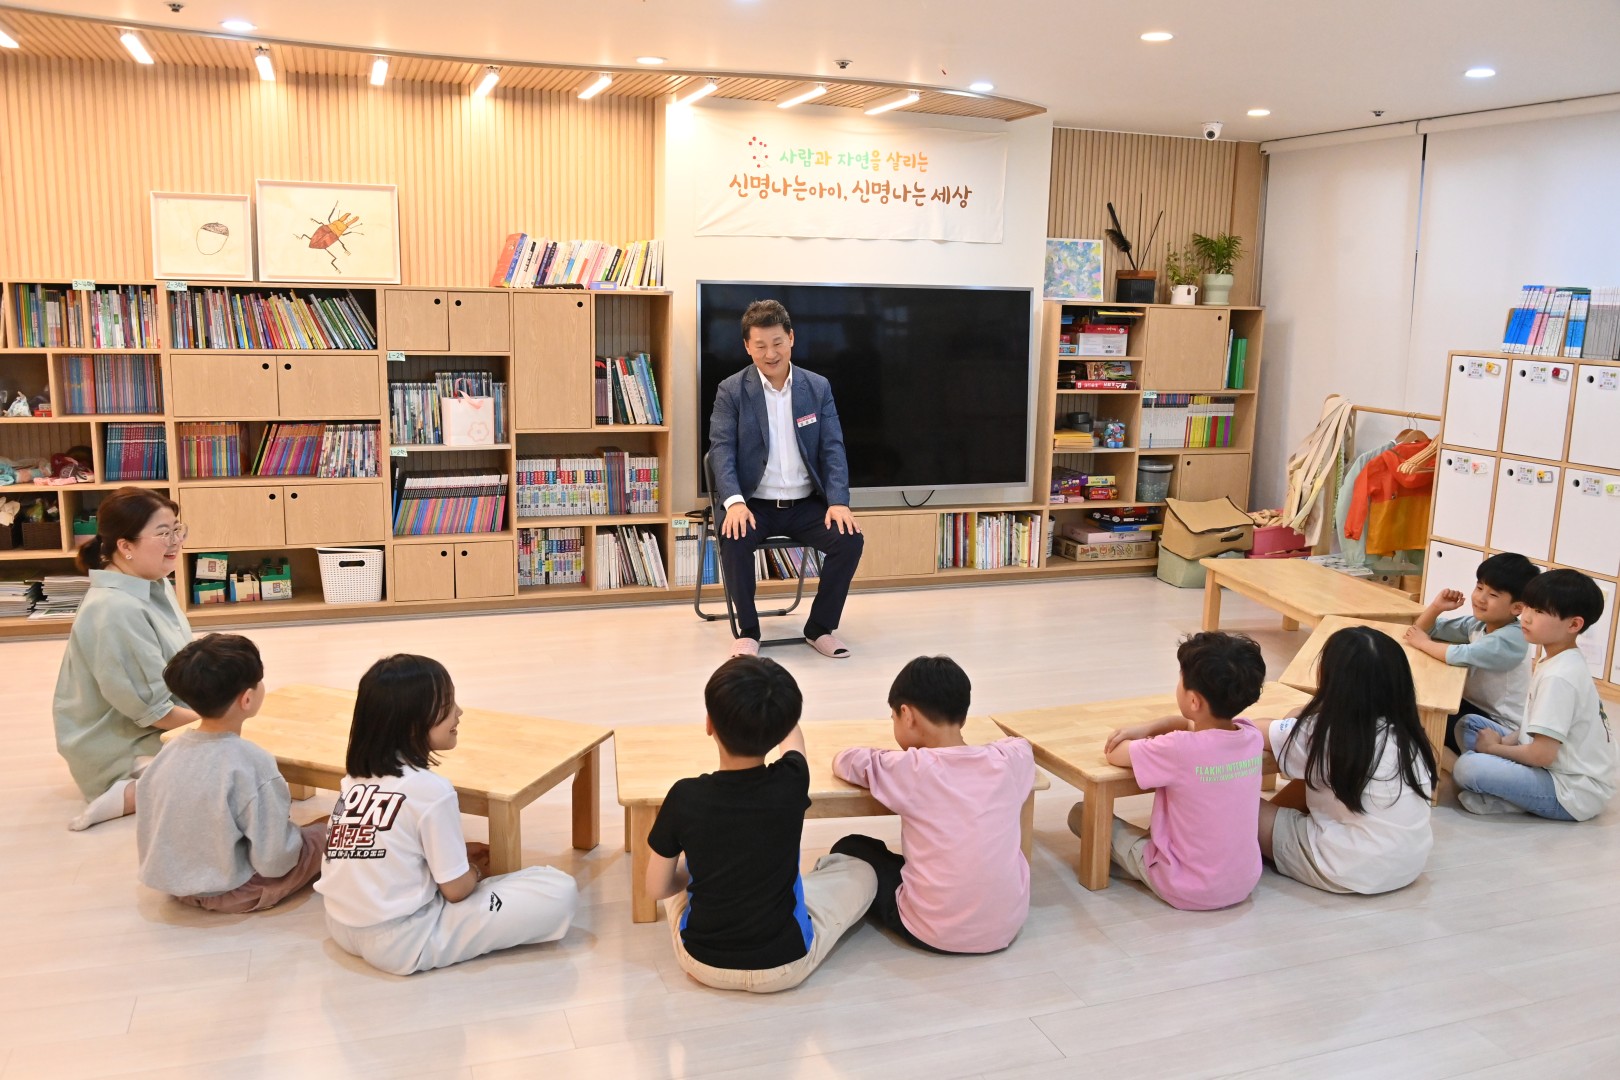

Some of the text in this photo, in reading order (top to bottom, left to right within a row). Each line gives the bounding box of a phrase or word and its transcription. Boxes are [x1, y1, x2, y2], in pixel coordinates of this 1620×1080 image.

[779, 148, 928, 173] 사람과 자연을 살리는
[852, 179, 927, 207] 신명나는
[931, 185, 973, 209] 세상
[339, 784, 406, 830] 인지
[328, 824, 377, 849] 태권도
